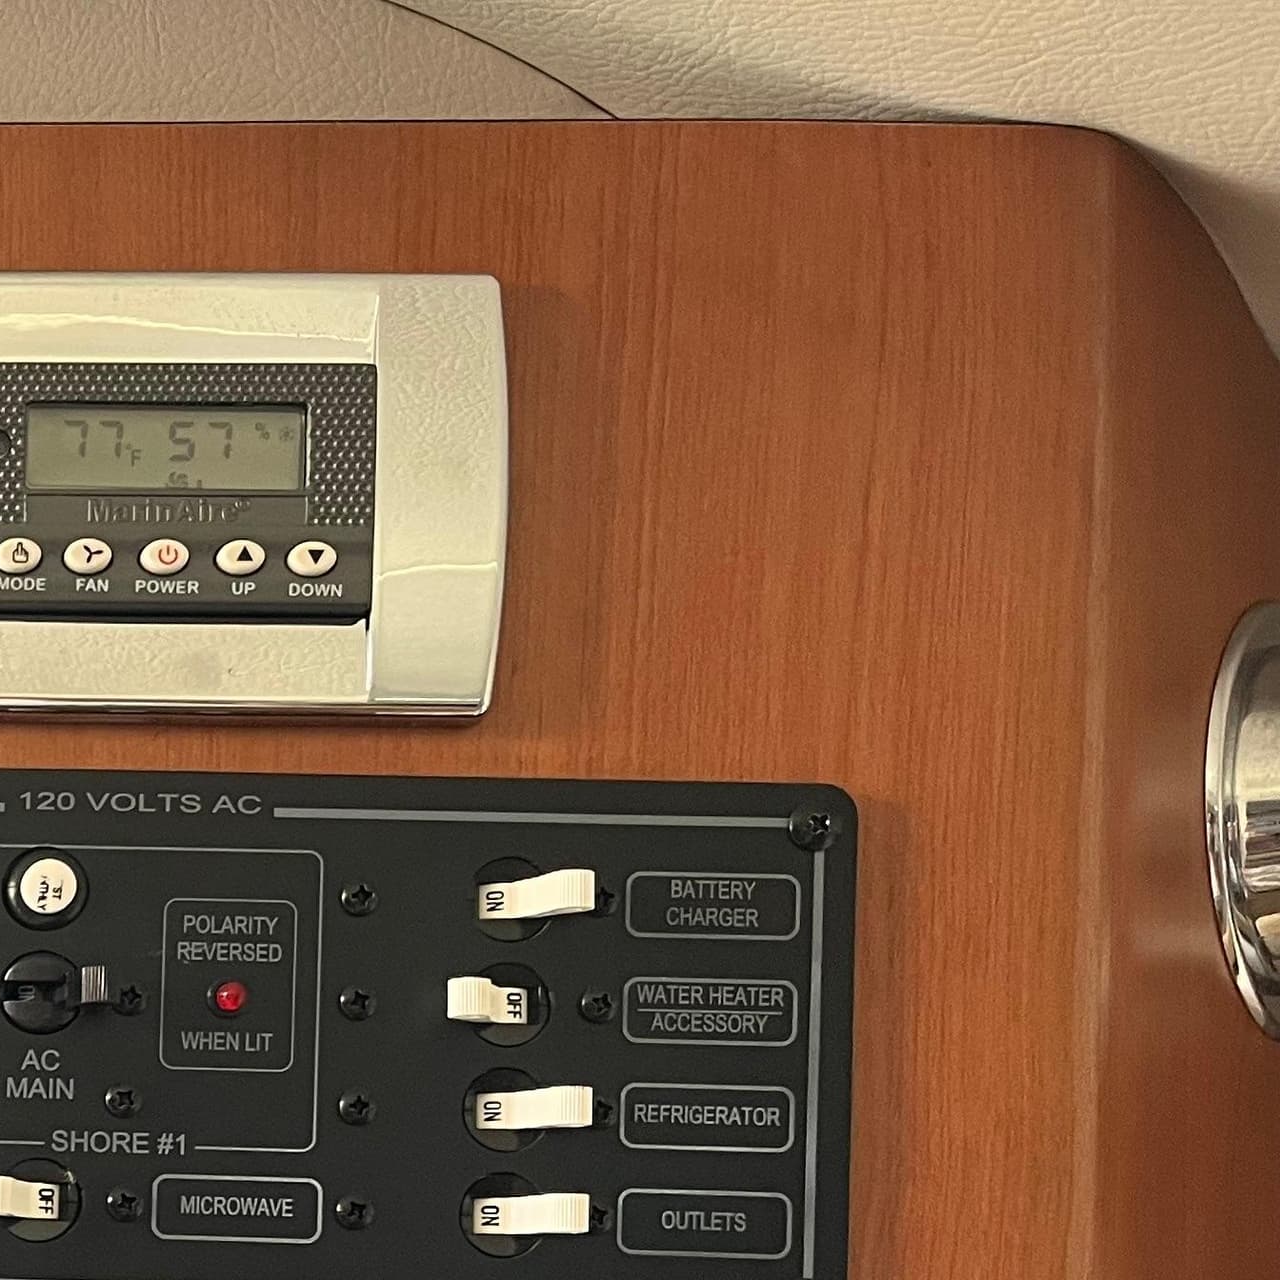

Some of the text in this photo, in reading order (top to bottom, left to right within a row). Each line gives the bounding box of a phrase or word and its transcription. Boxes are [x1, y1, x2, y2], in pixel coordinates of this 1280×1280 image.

[64, 420, 124, 459] 77
[169, 421, 233, 462] 57
[75, 578, 109, 593] FAN
[135, 579, 200, 595] POWER
[231, 581, 256, 596] UP
[288, 582, 343, 598] DOWN
[19, 791, 262, 815] 120 VOLTS AC
[485, 890, 505, 913] ON
[670, 880, 756, 901] BATTERY
[183, 915, 280, 936] POLARITY
[666, 907, 759, 928] CHARGER
[177, 942, 282, 963] REVERSED
[506, 992, 522, 1019] OFF
[637, 984, 784, 1007] WATER HEATER
[651, 1014, 768, 1034] ACCESSORY
[181, 1031, 273, 1052] WHEN LIT
[21, 1049, 61, 1072] AC
[6, 1077, 75, 1100] MAIN
[483, 1100, 502, 1123] ON
[634, 1104, 781, 1127] REFRIGERATOR
[50, 1130, 187, 1155] SHORE #1
[37, 1188, 55, 1216] OFF
[180, 1195, 294, 1217] MICROWAVE
[481, 1205, 500, 1227] ON
[661, 1211, 747, 1232] OUTLETS
